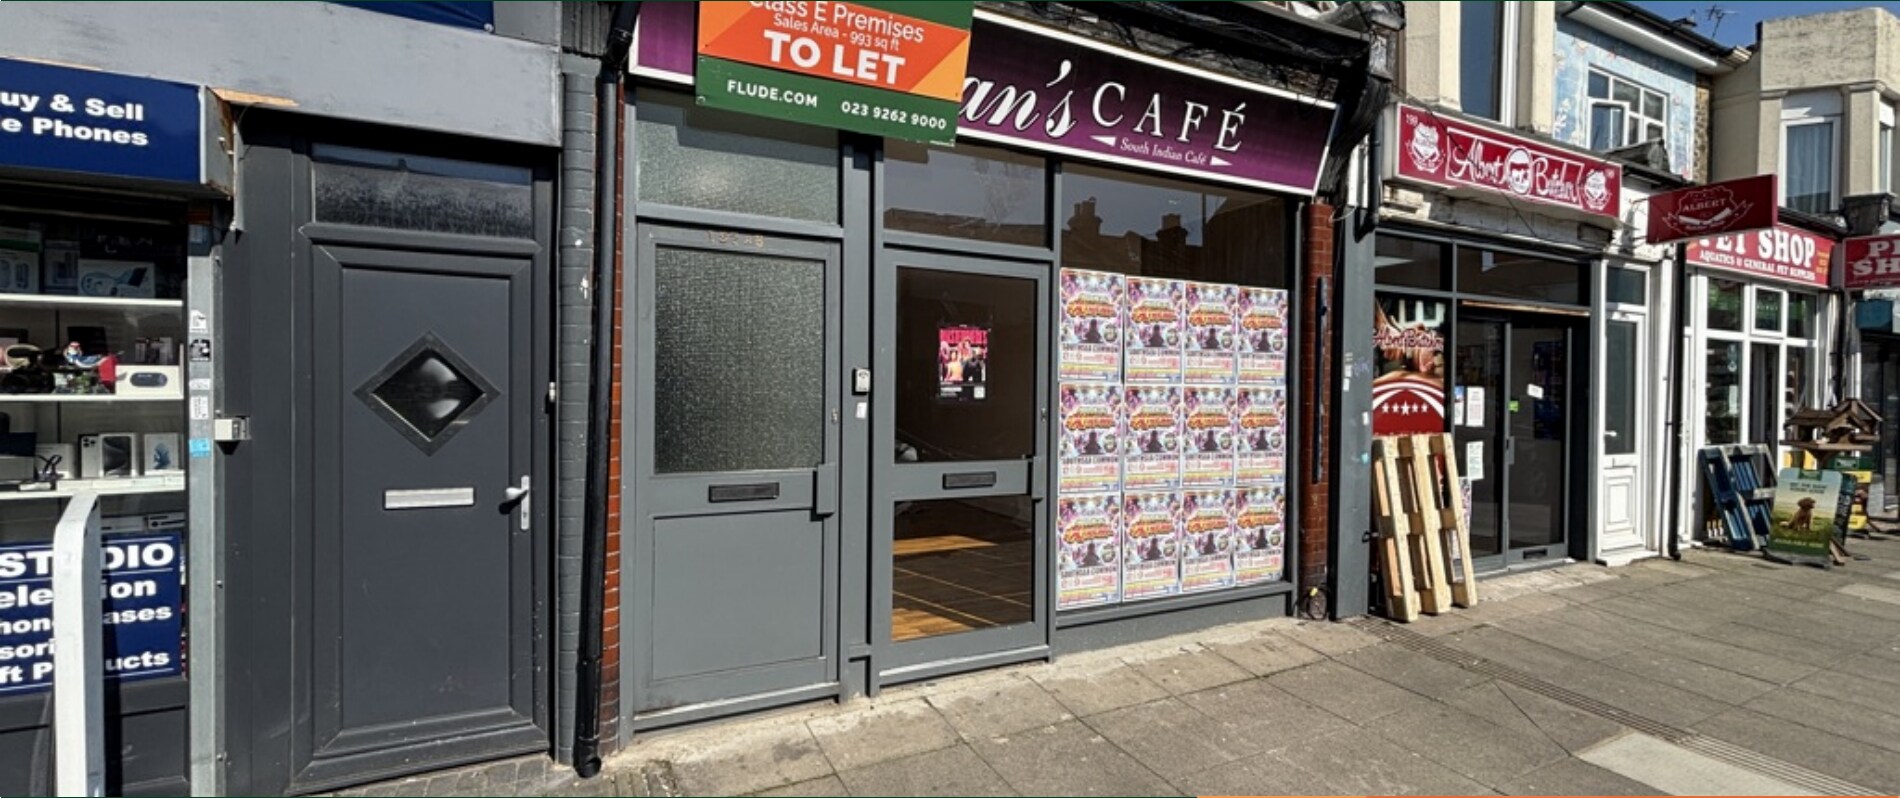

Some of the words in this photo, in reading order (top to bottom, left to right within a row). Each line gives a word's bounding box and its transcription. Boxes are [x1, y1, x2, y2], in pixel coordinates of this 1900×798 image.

[774, 13, 808, 31] Sales
[811, 22, 839, 38] Area
[850, 31, 871, 48] 993
[873, 38, 887, 51] sq
[890, 38, 900, 51] ft
[814, 4, 827, 21] E
[833, 5, 924, 43] Premises
[764, 29, 821, 68] TO
[832, 44, 906, 85] LET
[50, 94, 75, 113] &
[85, 98, 144, 121] Sell
[727, 80, 818, 108] FLUDE.COM
[841, 101, 869, 117] 023
[873, 104, 907, 123] 9262
[911, 111, 947, 130] 9000
[1092, 82, 1246, 152] CAFÉ
[32, 117, 149, 146] Phones
[1120, 137, 1150, 155] South
[1152, 145, 1183, 161] Indian
[1185, 150, 1207, 165] Café
[1683, 199, 1726, 212] ALBERT
[1699, 233, 1746, 255] ET
[1758, 228, 1816, 268] SHOP
[1700, 250, 1735, 265] AQUATICS
[1744, 258, 1775, 273] GENERAL
[1777, 265, 1788, 275] PET
[0, 542, 175, 578] STDIO
[0, 579, 157, 609] eleion
[103, 606, 173, 624] ases
[33, 651, 170, 680] Pucts
